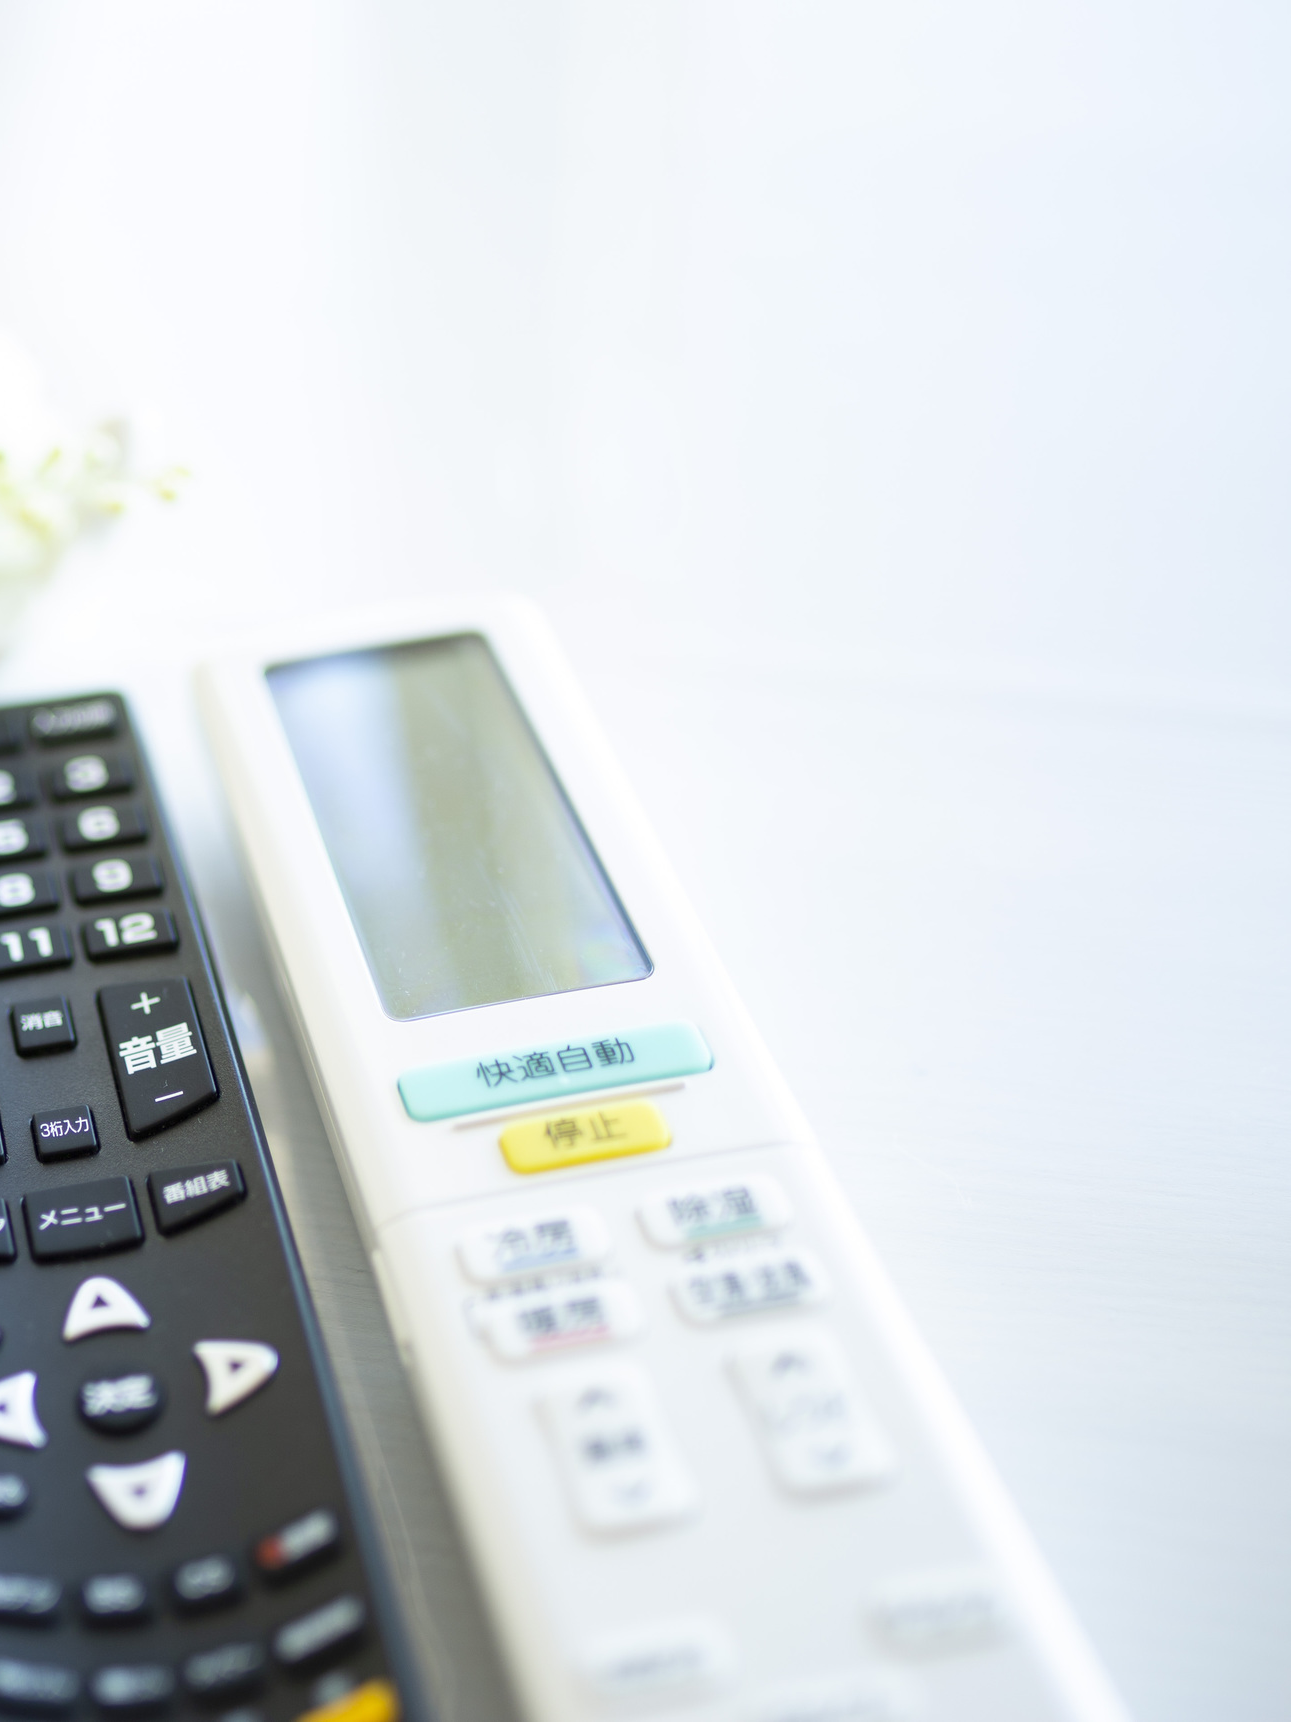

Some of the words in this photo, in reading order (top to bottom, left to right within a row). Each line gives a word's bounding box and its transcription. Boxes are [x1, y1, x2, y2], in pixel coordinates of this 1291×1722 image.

[92, 859, 133, 892] 9
[0, 927, 53, 962] 11
[94, 912, 157, 947] 12
[20, 1010, 64, 1032] 消音
[118, 1022, 198, 1075] 音量
[475, 1037, 636, 1088] 快適自動
[39, 1116, 90, 1138] 3桁入力
[543, 1111, 628, 1150] 停止
[162, 1169, 231, 1205] 番組表
[39, 1203, 127, 1231] メニュー
